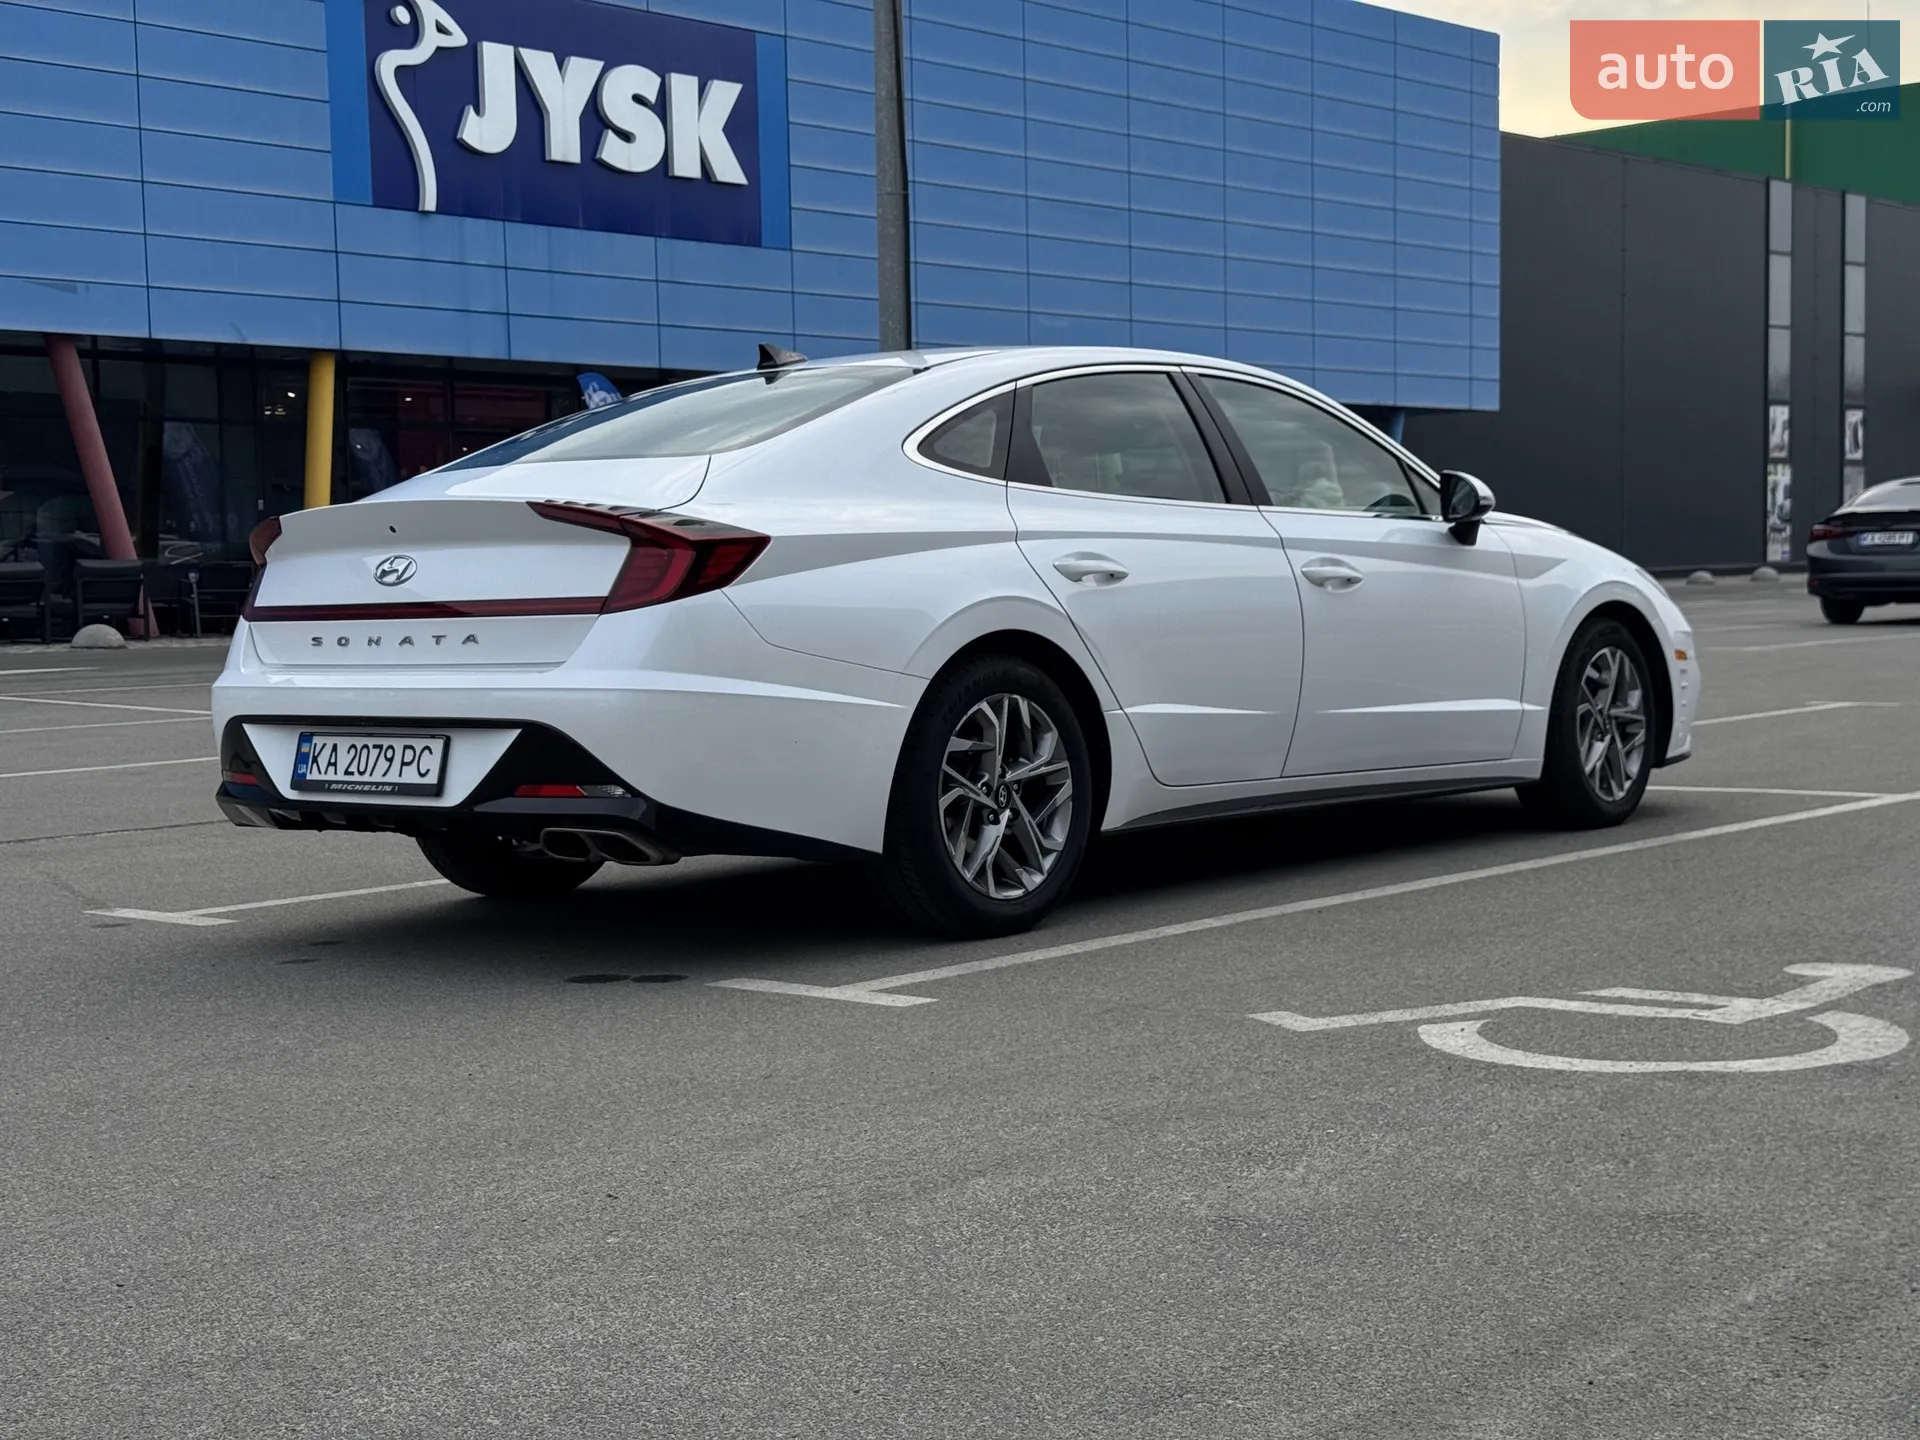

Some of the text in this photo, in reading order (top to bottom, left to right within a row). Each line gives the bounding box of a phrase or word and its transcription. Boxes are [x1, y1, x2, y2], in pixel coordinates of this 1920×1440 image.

[457, 40, 749, 186] JYSK
[311, 633, 480, 647] SONATA
[309, 742, 434, 778] KA 2079 PC
[330, 783, 393, 792] MICHELIN
